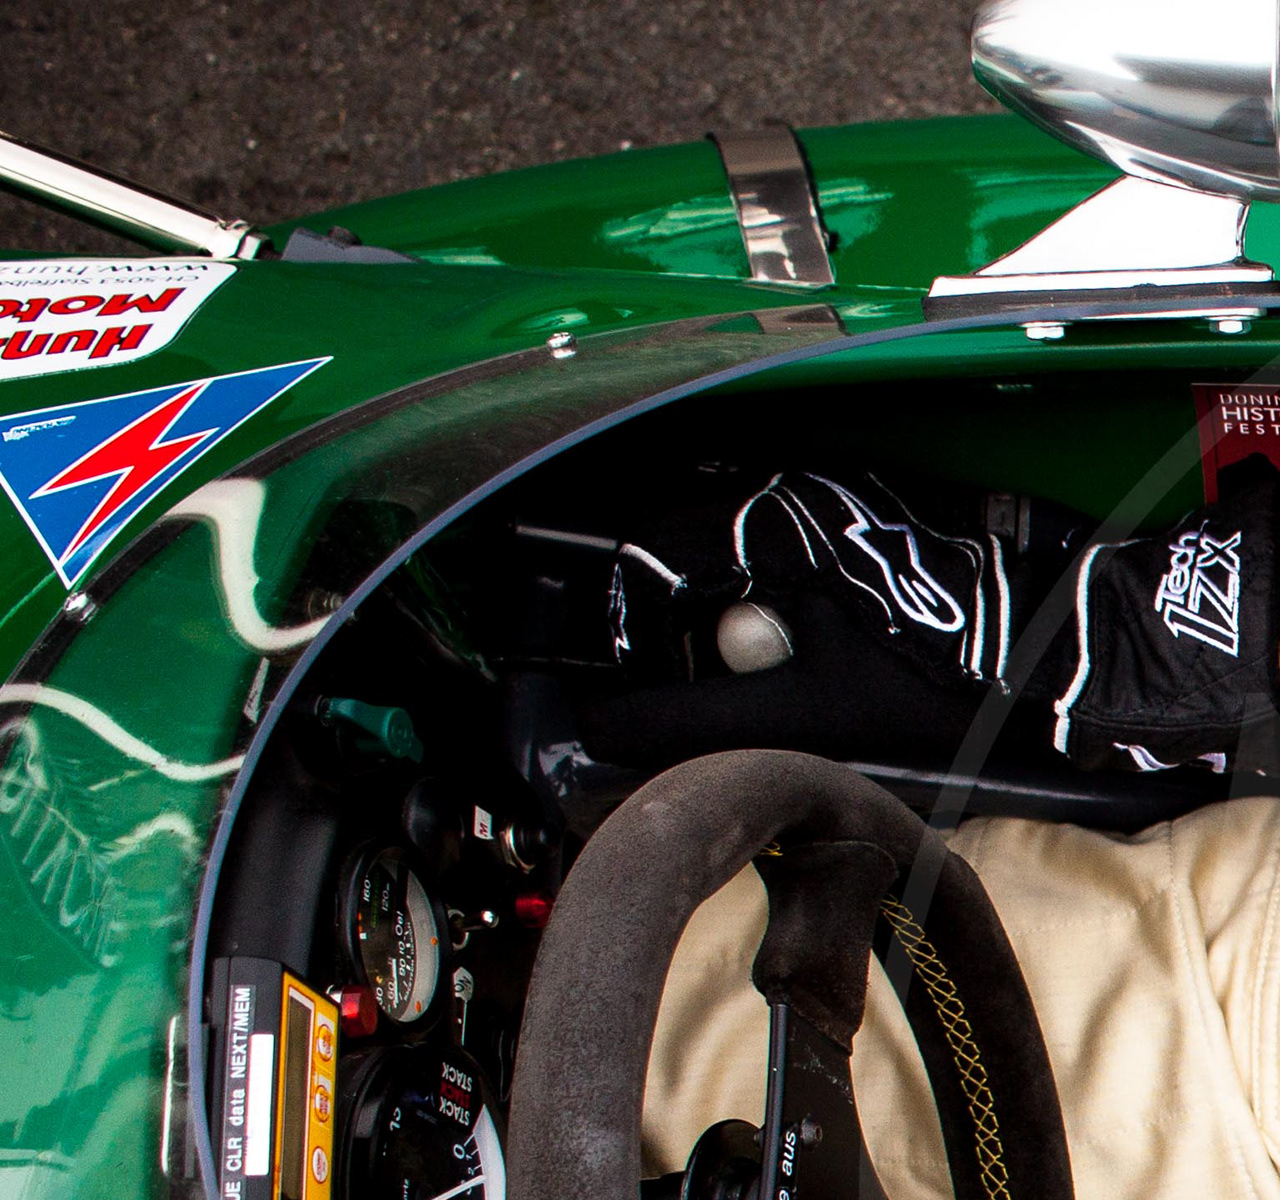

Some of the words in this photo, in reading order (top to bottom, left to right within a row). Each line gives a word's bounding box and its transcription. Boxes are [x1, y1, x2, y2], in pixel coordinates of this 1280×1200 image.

[0, 323, 154, 360] Hun
[1155, 530, 1199, 613] Tech
[231, 986, 252, 1079] NEXT/MEM
[440, 1060, 474, 1092] STACK
[229, 1088, 246, 1127] data
[438, 1095, 471, 1127] STACK
[226, 1136, 243, 1172] CLR
[779, 1129, 797, 1177] aus
